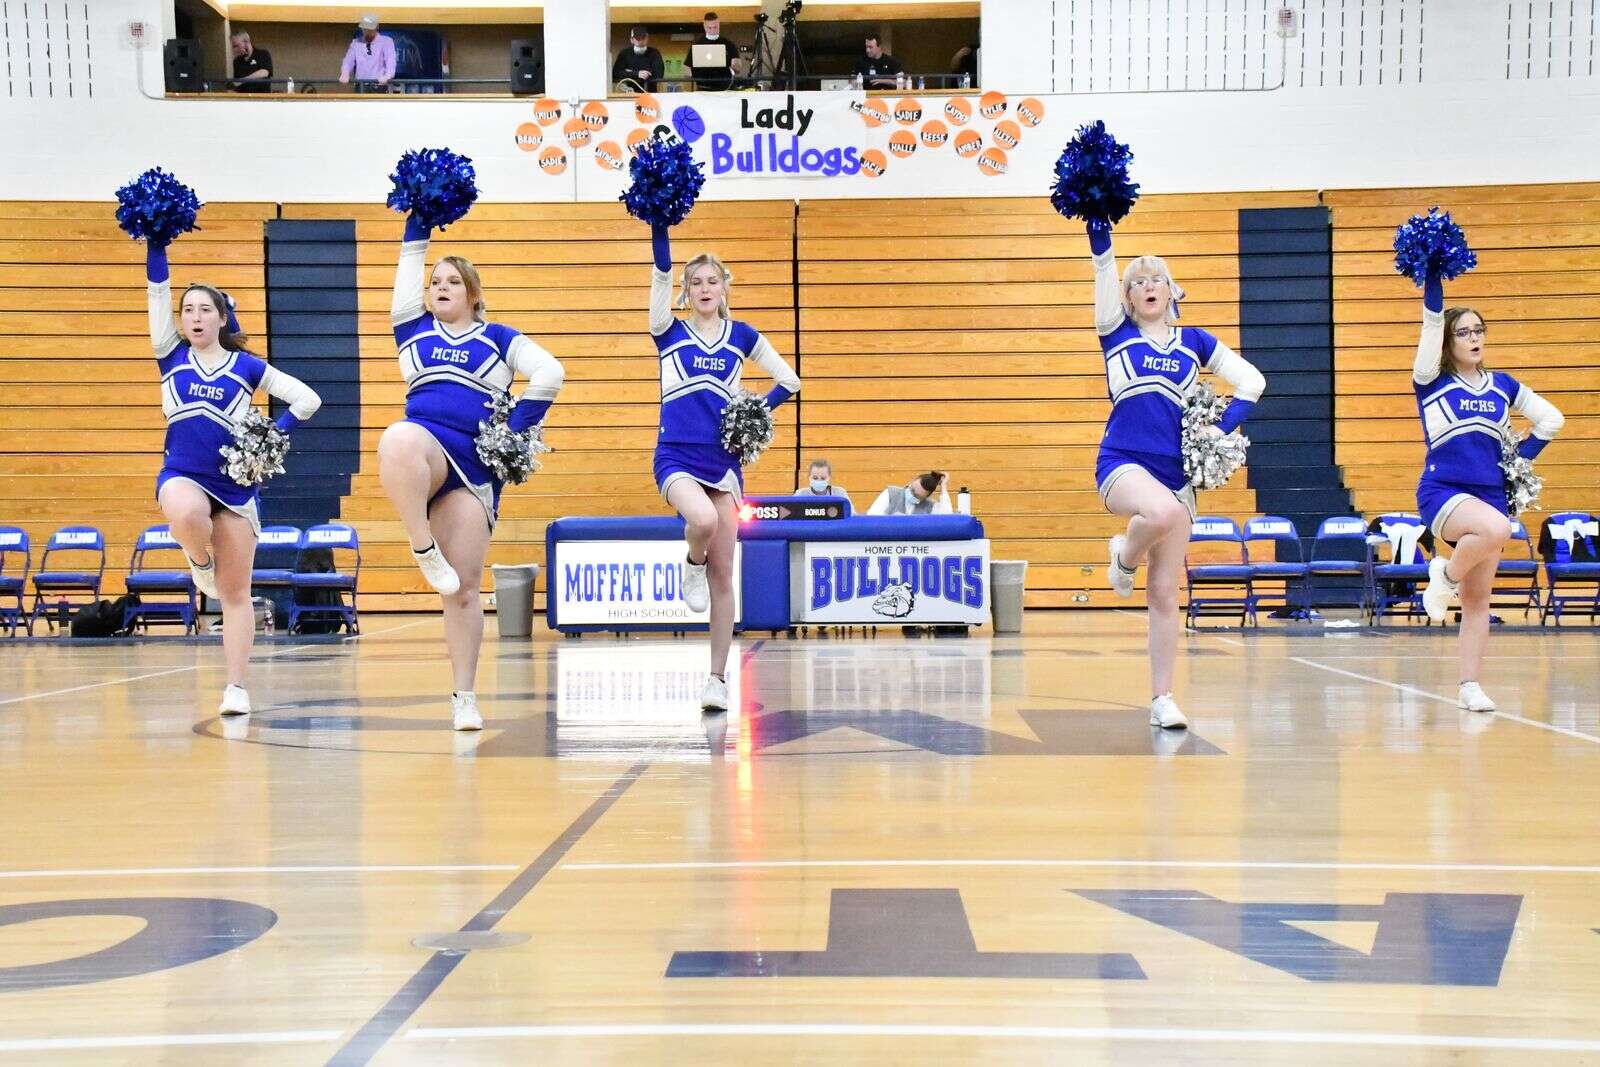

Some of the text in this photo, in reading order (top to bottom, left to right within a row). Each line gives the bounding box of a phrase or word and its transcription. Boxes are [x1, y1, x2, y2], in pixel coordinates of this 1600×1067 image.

[583, 114, 605, 125] TEYA
[740, 94, 814, 136] Lady
[896, 111, 919, 121] SADIE
[518, 134, 542, 144] BROOK
[923, 133, 946, 142] REESE
[891, 143, 914, 152] HALLE
[958, 140, 981, 154] AMBER
[711, 133, 861, 177] Bulldogs
[539, 156, 562, 168] SADIE
[431, 346, 470, 364] MCHS
[693, 355, 726, 371] MCHS
[1142, 355, 1181, 372] MCHS
[188, 382, 225, 400] MCHS
[1460, 398, 1497, 413] MCHS
[751, 506, 779, 518] POSS
[805, 508, 826, 516] BONUS
[864, 546, 929, 554] HOME OF THE
[564, 563, 646, 602] MOFFAT
[811, 556, 983, 611] BULLDOGS
[608, 609, 689, 618] HIGH SCHOOL
